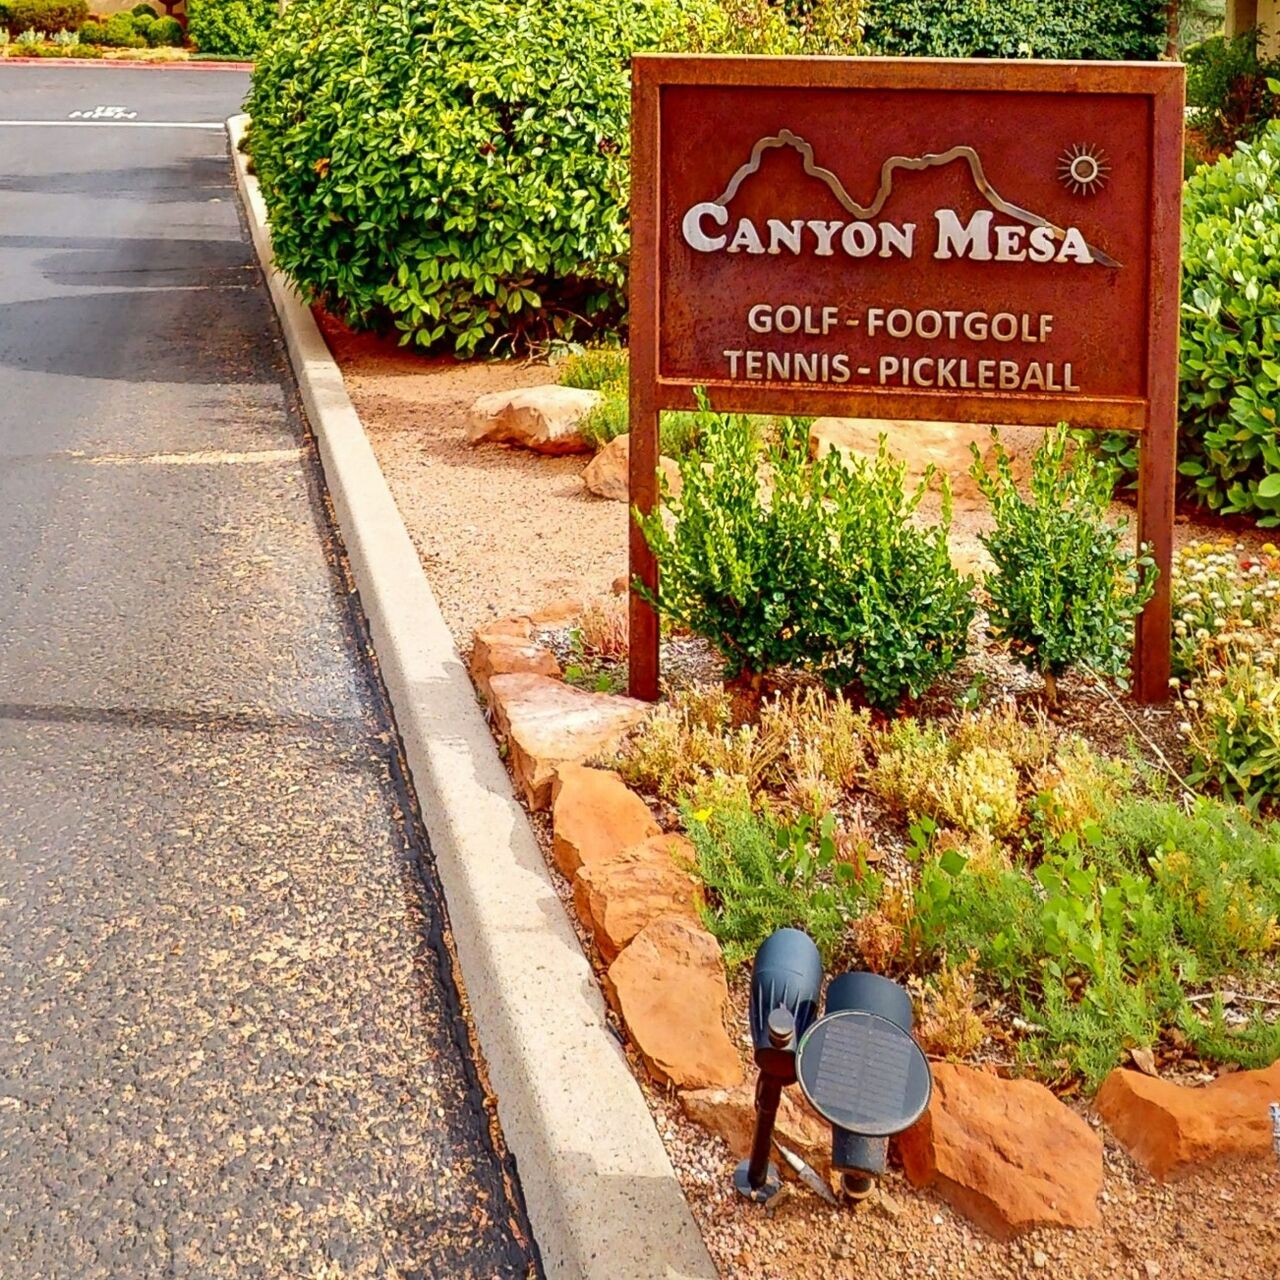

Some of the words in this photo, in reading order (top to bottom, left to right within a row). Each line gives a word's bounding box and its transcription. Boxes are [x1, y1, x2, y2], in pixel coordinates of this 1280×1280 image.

[682, 202, 917, 259] CANYON
[933, 208, 1095, 265] MESA
[748, 304, 839, 336] GOLF
[867, 307, 1054, 343] FOOTGOLF
[723, 349, 850, 384] TENNIS
[878, 355, 1081, 393] PICKLEBALL
